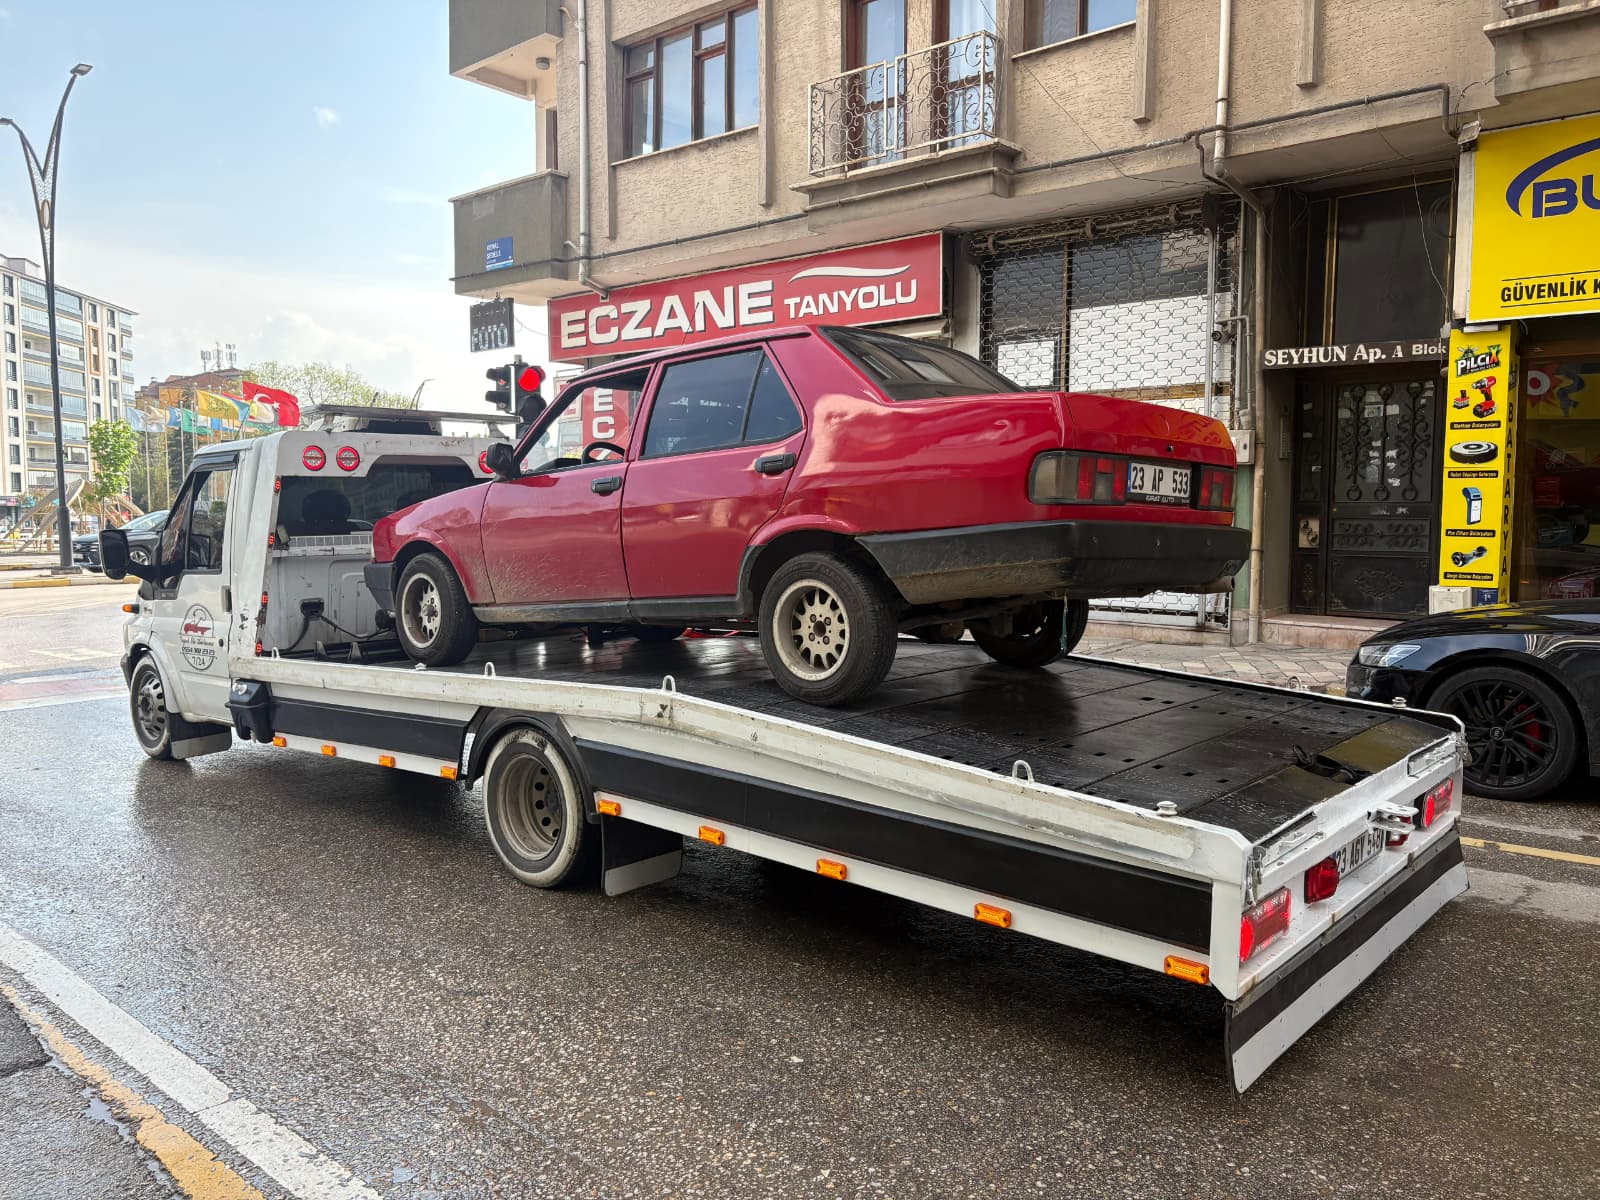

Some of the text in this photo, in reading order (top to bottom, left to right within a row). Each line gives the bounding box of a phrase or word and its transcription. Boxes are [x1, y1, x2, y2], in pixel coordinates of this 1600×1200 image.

[1500, 276, 1588, 303] GÜVENLİK
[560, 278, 918, 349] ECZANE TANYOLU
[1264, 342, 1447, 366] SEYHUN Ap. A Blok
[1131, 466, 1189, 495] 23 AP 533
[1501, 401, 1514, 577] BATARYA
